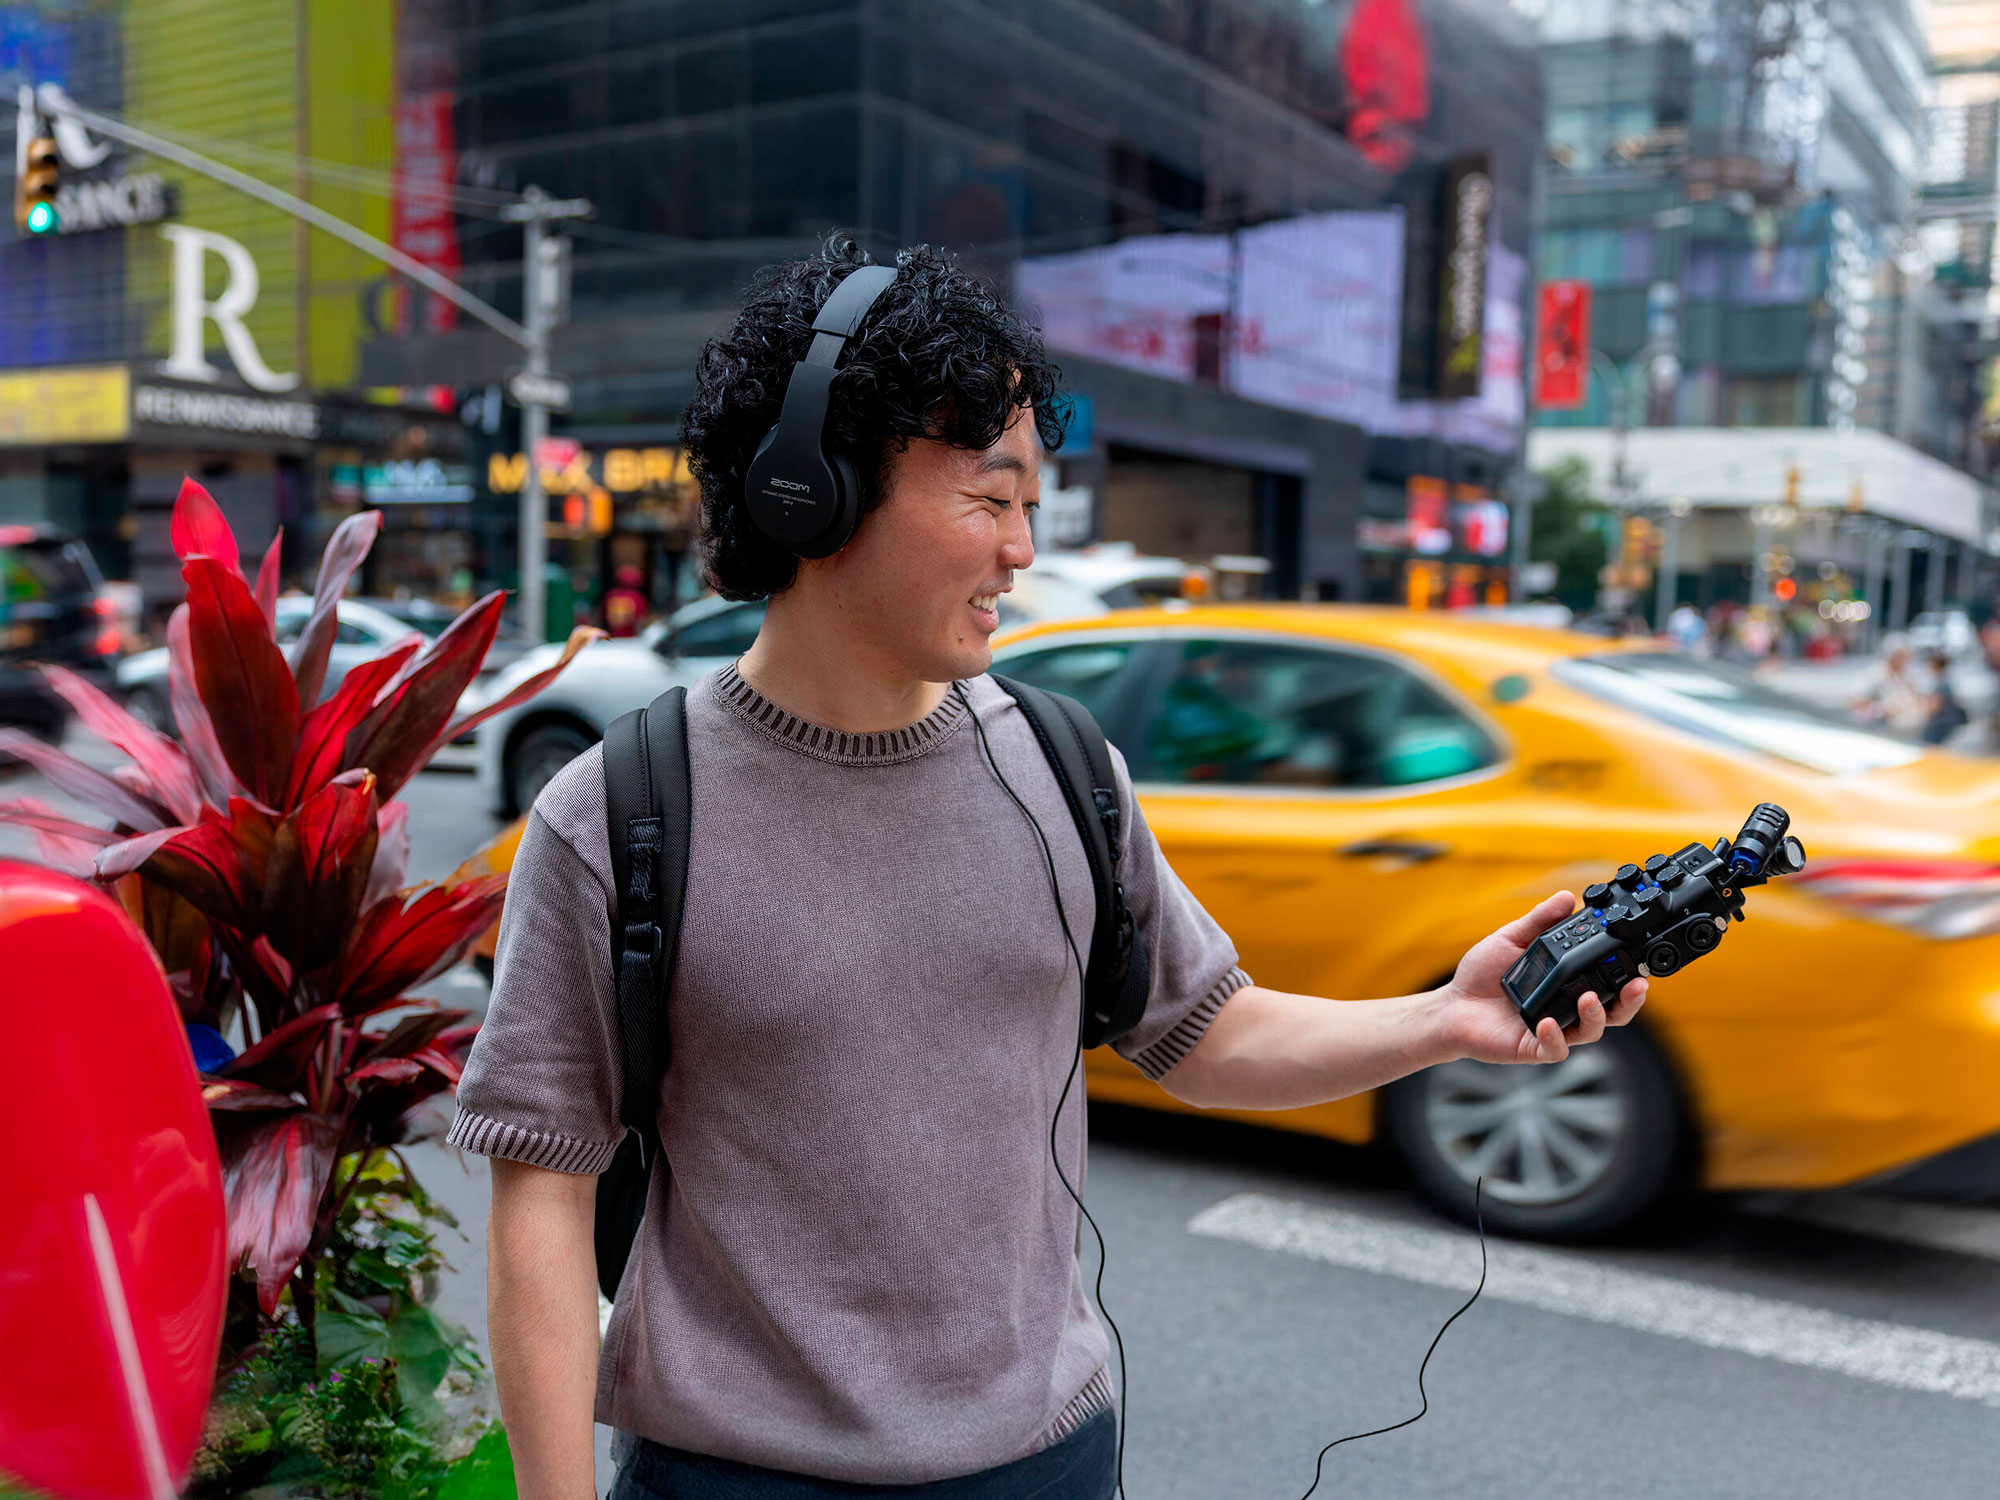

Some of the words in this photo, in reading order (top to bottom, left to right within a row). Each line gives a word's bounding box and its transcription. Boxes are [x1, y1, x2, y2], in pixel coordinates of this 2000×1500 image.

[155, 222, 301, 393] R
[770, 477, 810, 493] ZOOM
[1684, 907, 1691, 915] 2
